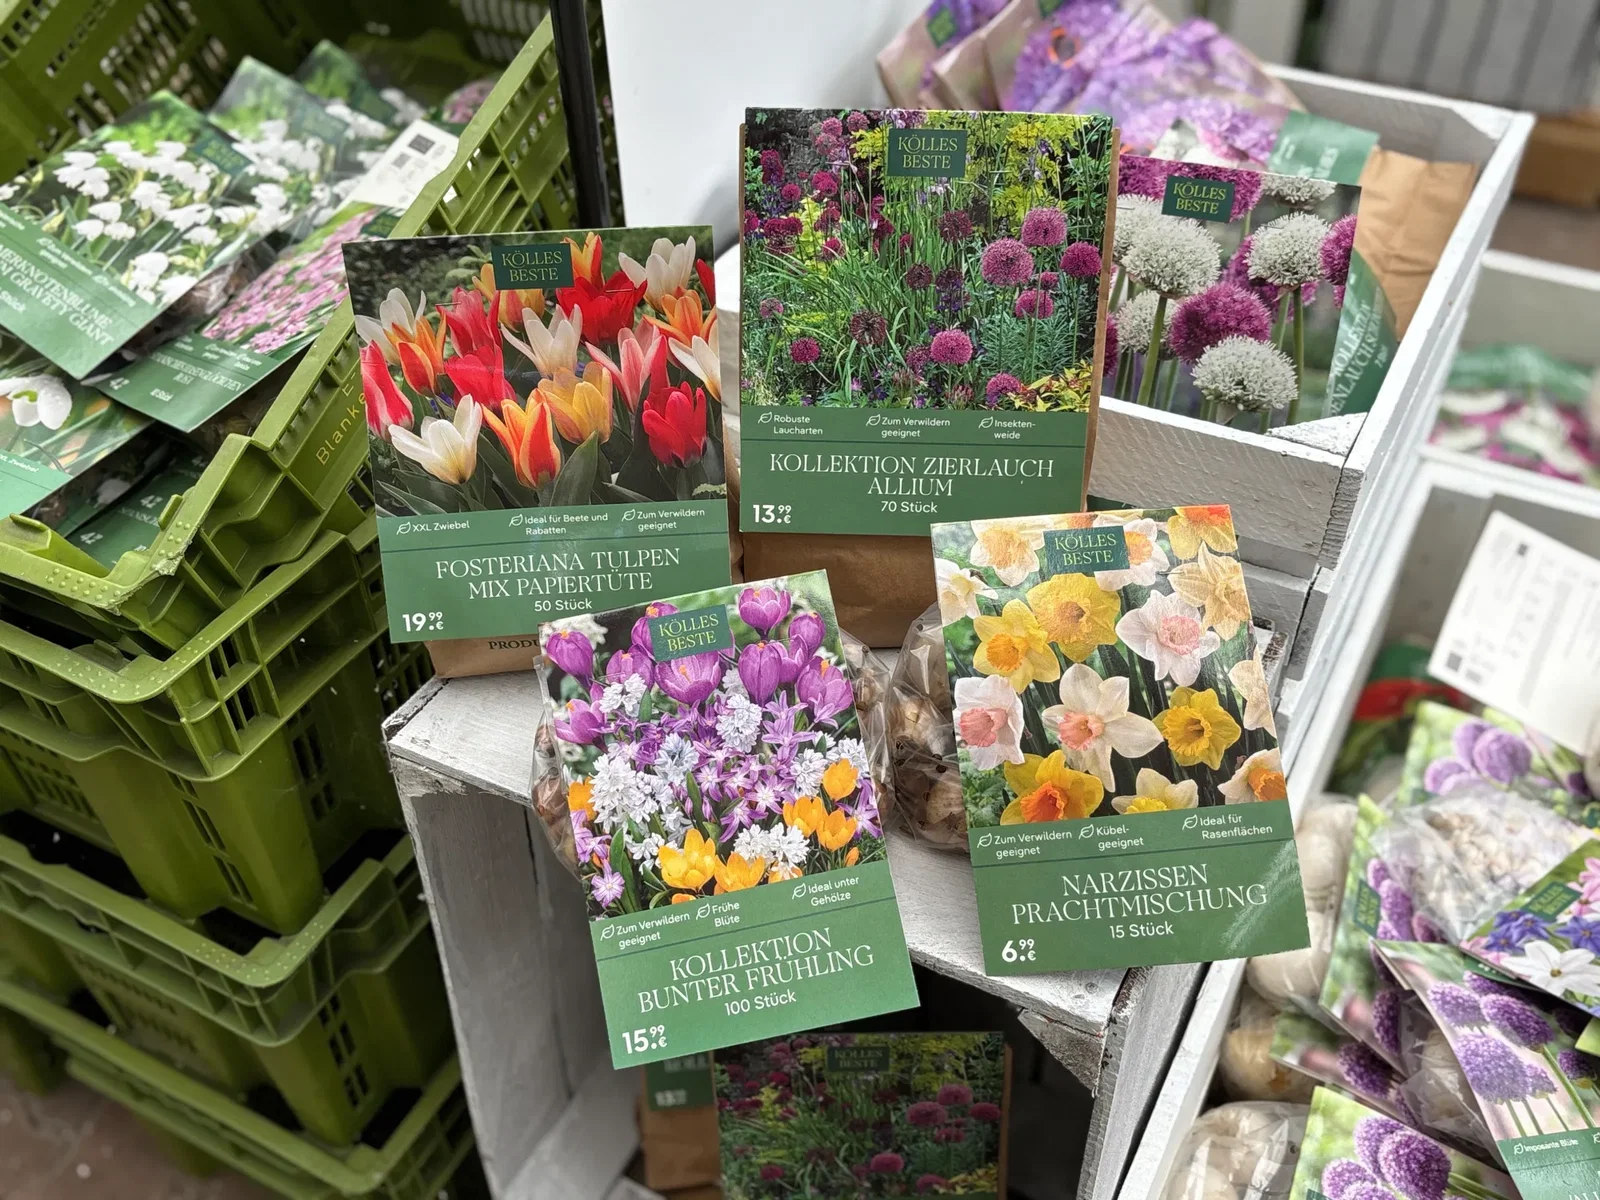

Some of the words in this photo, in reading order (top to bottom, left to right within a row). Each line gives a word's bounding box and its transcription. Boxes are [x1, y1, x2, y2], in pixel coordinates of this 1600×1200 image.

[898, 134, 958, 154] KÖLLES
[903, 154, 951, 168] BESTE
[1174, 182, 1226, 200] KÖLLES
[1176, 198, 1220, 214] BESTE
[502, 250, 562, 268] KÖLLES
[510, 268, 558, 282] BESTE
[774, 414, 811, 424] Robuste
[882, 418, 901, 427] Zum
[903, 418, 951, 428] Verwildern
[994, 419, 1036, 430] Insekten-
[773, 426, 824, 436] Laucharten
[881, 428, 921, 438] geeignet
[994, 430, 1021, 440] weide
[770, 454, 916, 475] KOLLEKTION
[923, 457, 1054, 478] ZIERLAUCH
[868, 478, 954, 496] ALLIUM
[636, 510, 657, 520] Zum
[658, 508, 705, 518] Verwildern
[880, 502, 898, 512] 70
[900, 502, 938, 514] Stück
[524, 514, 547, 524] Ideal
[549, 513, 562, 523] für
[563, 513, 589, 523] Beete
[590, 512, 609, 522] und
[412, 523, 432, 532] XXL
[433, 520, 470, 530] Zwiebel
[525, 526, 567, 536] Rabatten
[637, 520, 678, 532] geeignet
[1055, 534, 1116, 552] KÖLLES
[436, 552, 585, 580] FOSTERIANA
[590, 547, 681, 570] TULPEN
[1063, 550, 1114, 566] BESTE
[468, 580, 511, 600] MIX
[517, 571, 654, 597] PAPIERTÜTE
[534, 600, 552, 612] 50
[554, 598, 593, 611] Stück
[659, 614, 719, 638] KÖLLES
[668, 630, 716, 652] BESTE
[1200, 816, 1226, 826] Ideal
[1228, 814, 1242, 824] für
[994, 834, 1016, 845] Zum
[1018, 830, 1072, 843] Verwildern
[1096, 826, 1130, 836] Kübel-
[1202, 825, 1273, 840] Rasenflächen
[1098, 837, 1144, 851] geeignet
[996, 846, 1041, 860] geeignet
[808, 882, 833, 894] Ideal
[834, 877, 860, 889] unter
[1062, 864, 1208, 896] NARZISSEN
[810, 892, 852, 906] Gehölze
[1012, 884, 1268, 924] PRACHTMISCHUNG
[712, 902, 740, 914] Frühe
[616, 924, 638, 936] Zum
[639, 912, 690, 930] Verwildern
[714, 915, 740, 928] Blüte
[1110, 925, 1124, 938] 15
[1129, 921, 1174, 937] Stück
[619, 932, 662, 950] geeignet
[670, 928, 832, 980] KOLLEKTION
[638, 974, 739, 1014] BUNTER
[748, 946, 874, 990] FRÜHLING
[724, 1000, 751, 1016] 100
[754, 990, 796, 1010] Stück
[1524, 1142, 1560, 1152] Imposante
